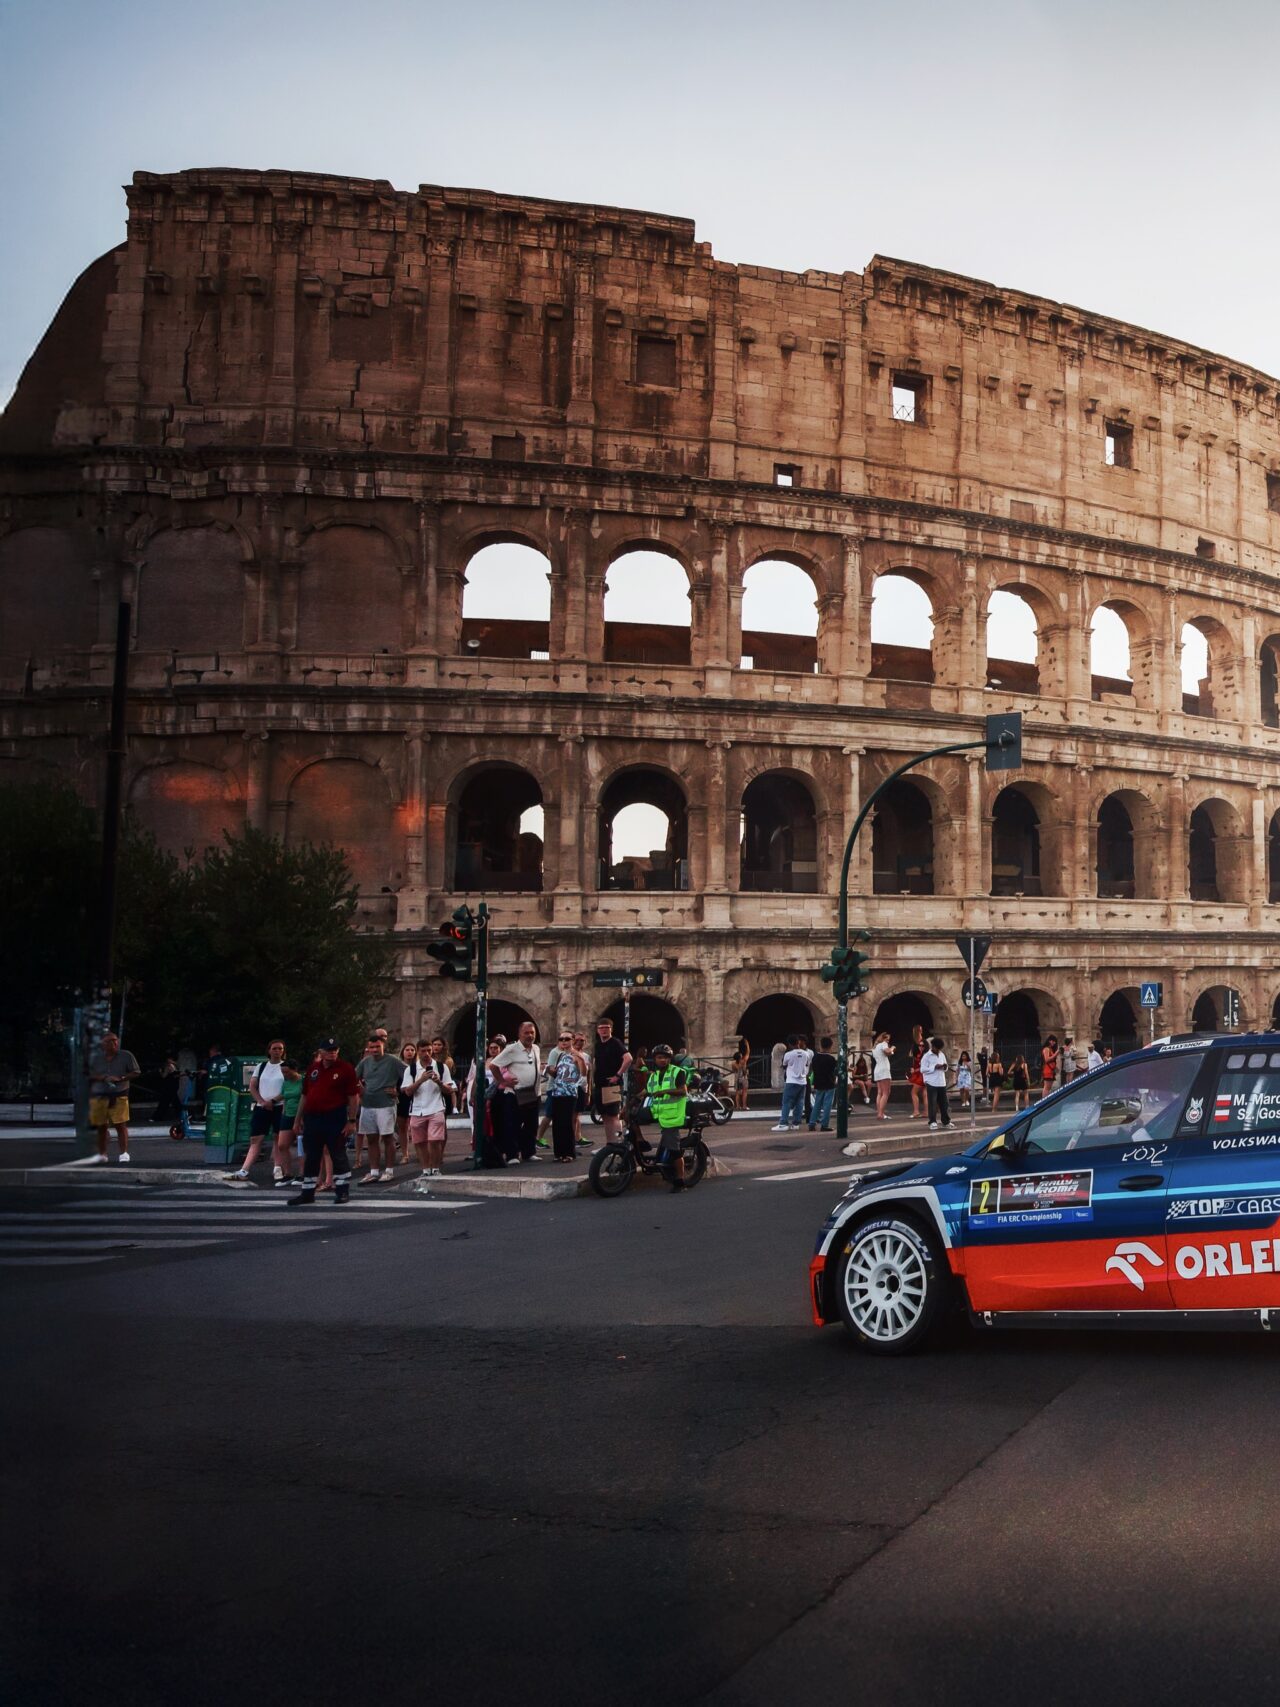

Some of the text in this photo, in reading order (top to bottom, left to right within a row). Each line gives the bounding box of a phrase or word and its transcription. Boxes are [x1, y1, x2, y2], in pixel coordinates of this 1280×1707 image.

[1233, 1094, 1248, 1106] M.
[1237, 1108, 1255, 1120] Sz.
[1040, 1184, 1079, 1194] ROMA
[979, 1181, 990, 1213] 2
[1008, 1215, 1020, 1223] ERC
[1021, 1213, 1062, 1222] Championship
